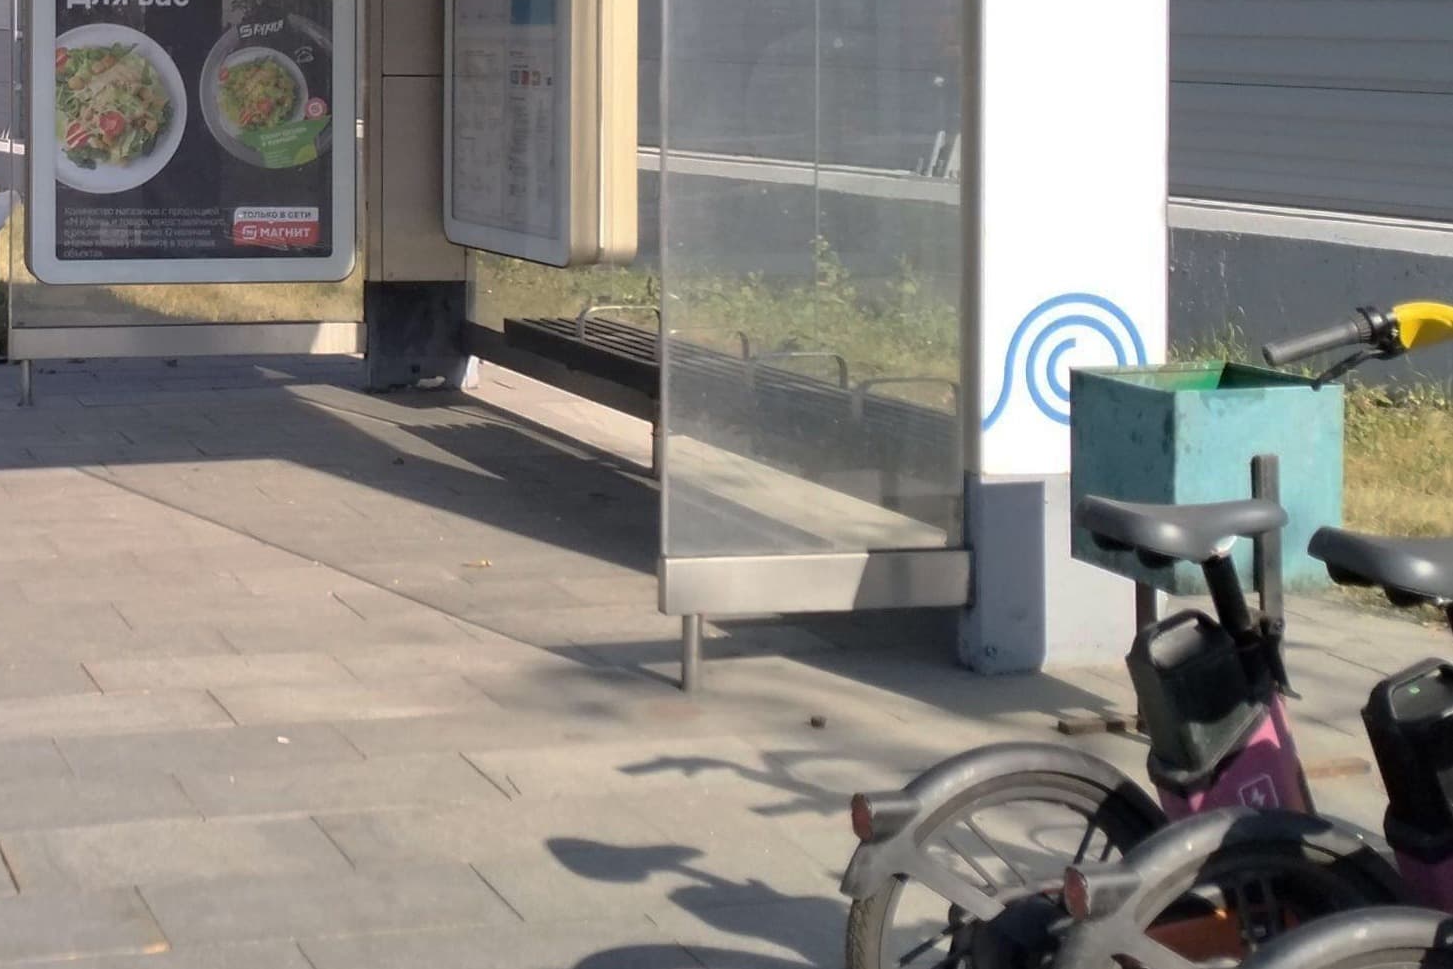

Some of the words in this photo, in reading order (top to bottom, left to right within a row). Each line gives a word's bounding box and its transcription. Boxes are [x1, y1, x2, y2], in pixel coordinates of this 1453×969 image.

[243, 210, 278, 219] ТОЛЬКО
[288, 210, 312, 219] СЕТИ
[259, 227, 311, 238] МАГНИТ
